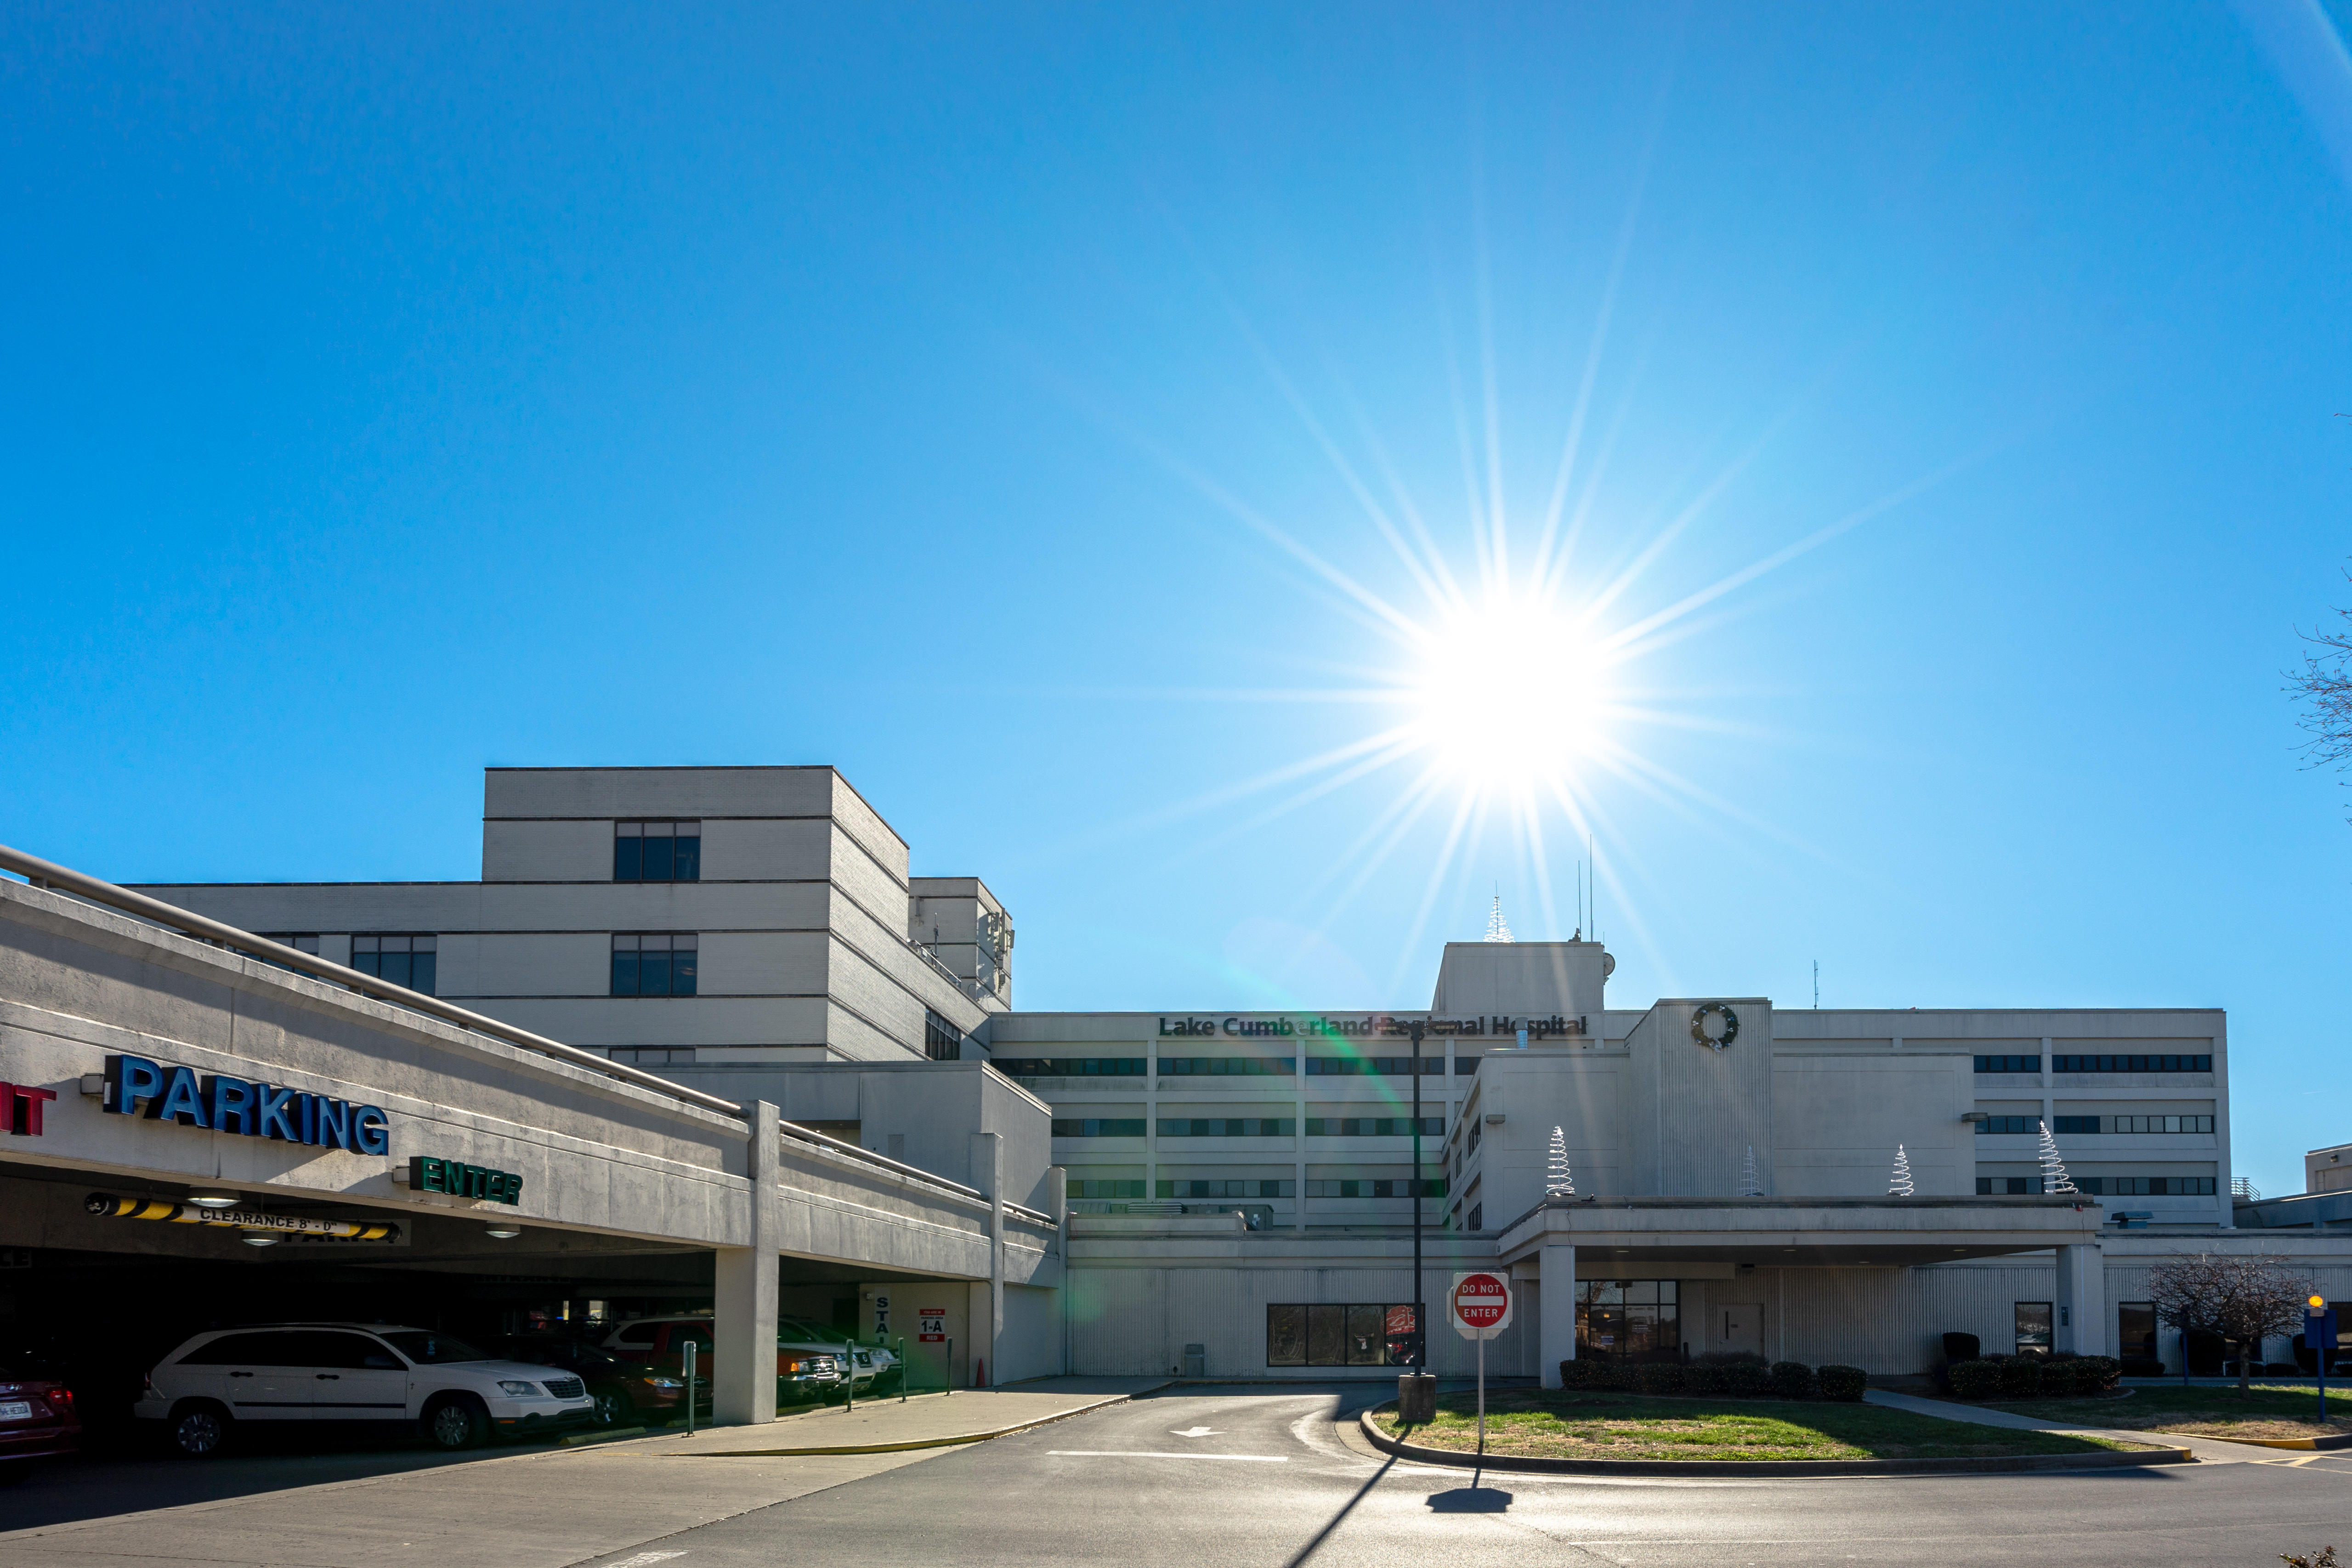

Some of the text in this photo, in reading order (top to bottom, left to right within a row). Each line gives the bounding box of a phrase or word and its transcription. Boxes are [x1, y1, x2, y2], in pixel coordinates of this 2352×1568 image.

[1159, 1017, 1215, 1036] Lake
[1223, 1016, 1373, 1036] Cumberland
[105, 1054, 389, 1156] PARKING
[411, 1156, 523, 1206] ENTER
[200, 1209, 295, 1228] CLEARANCE
[1462, 1285, 1500, 1293] DO NOT
[1464, 1308, 1498, 1317] ENTER
[921, 1320, 942, 1332] 1-A
